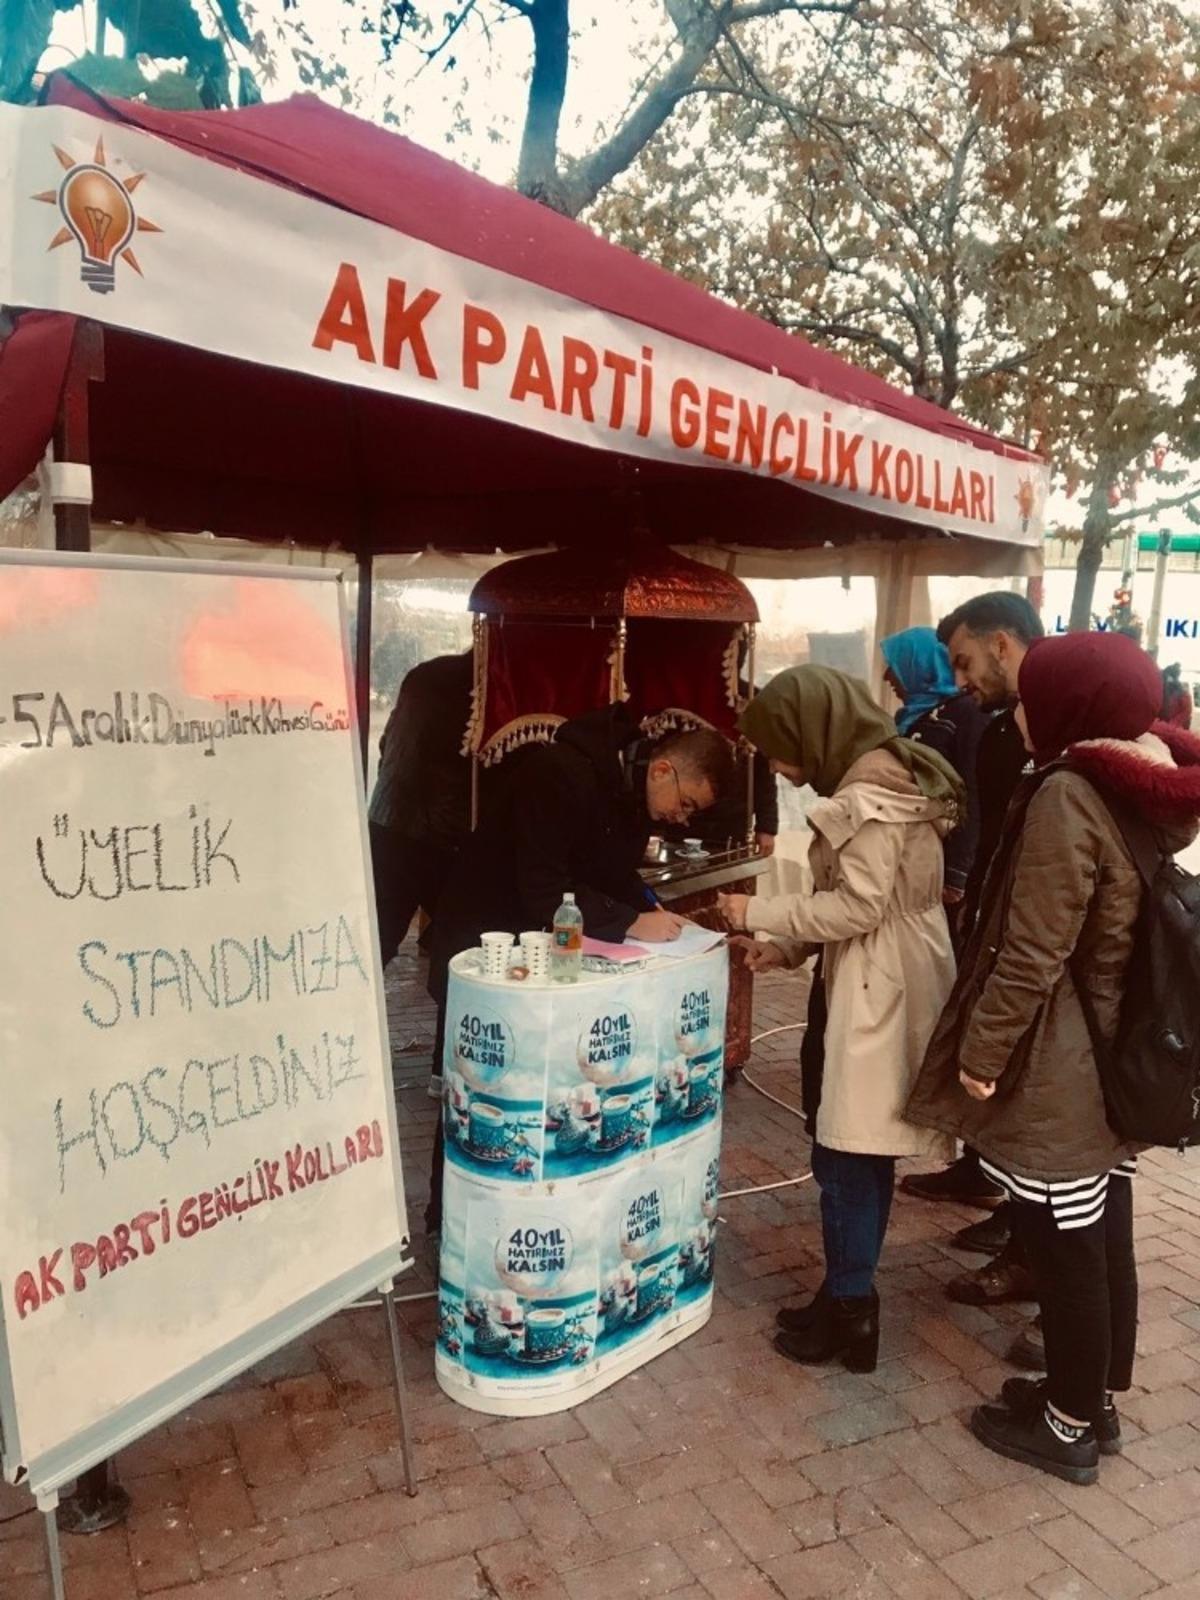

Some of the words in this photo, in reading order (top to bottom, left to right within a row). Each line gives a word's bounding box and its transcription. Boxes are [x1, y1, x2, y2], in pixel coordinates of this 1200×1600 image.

[312, 262, 442, 381] AK
[462, 304, 654, 438] PARTİ
[869, 440, 994, 524] KOLLARI
[36, 804, 240, 901] ÜYELİK
[77, 914, 370, 1029] STANDIMIZA
[458, 1043, 505, 1068] KALSIN
[588, 1041, 631, 1064] KALSIN
[54, 1031, 367, 1195] HOŞGELDİNİZ
[14, 1248, 65, 1320] AK
[71, 1199, 171, 1292] PARTİ
[177, 1158, 284, 1239] GENÇLİK
[285, 1119, 384, 1193] KOLLARI
[508, 1257, 565, 1273] KALSIN
[627, 1215, 660, 1243] KALSIN
